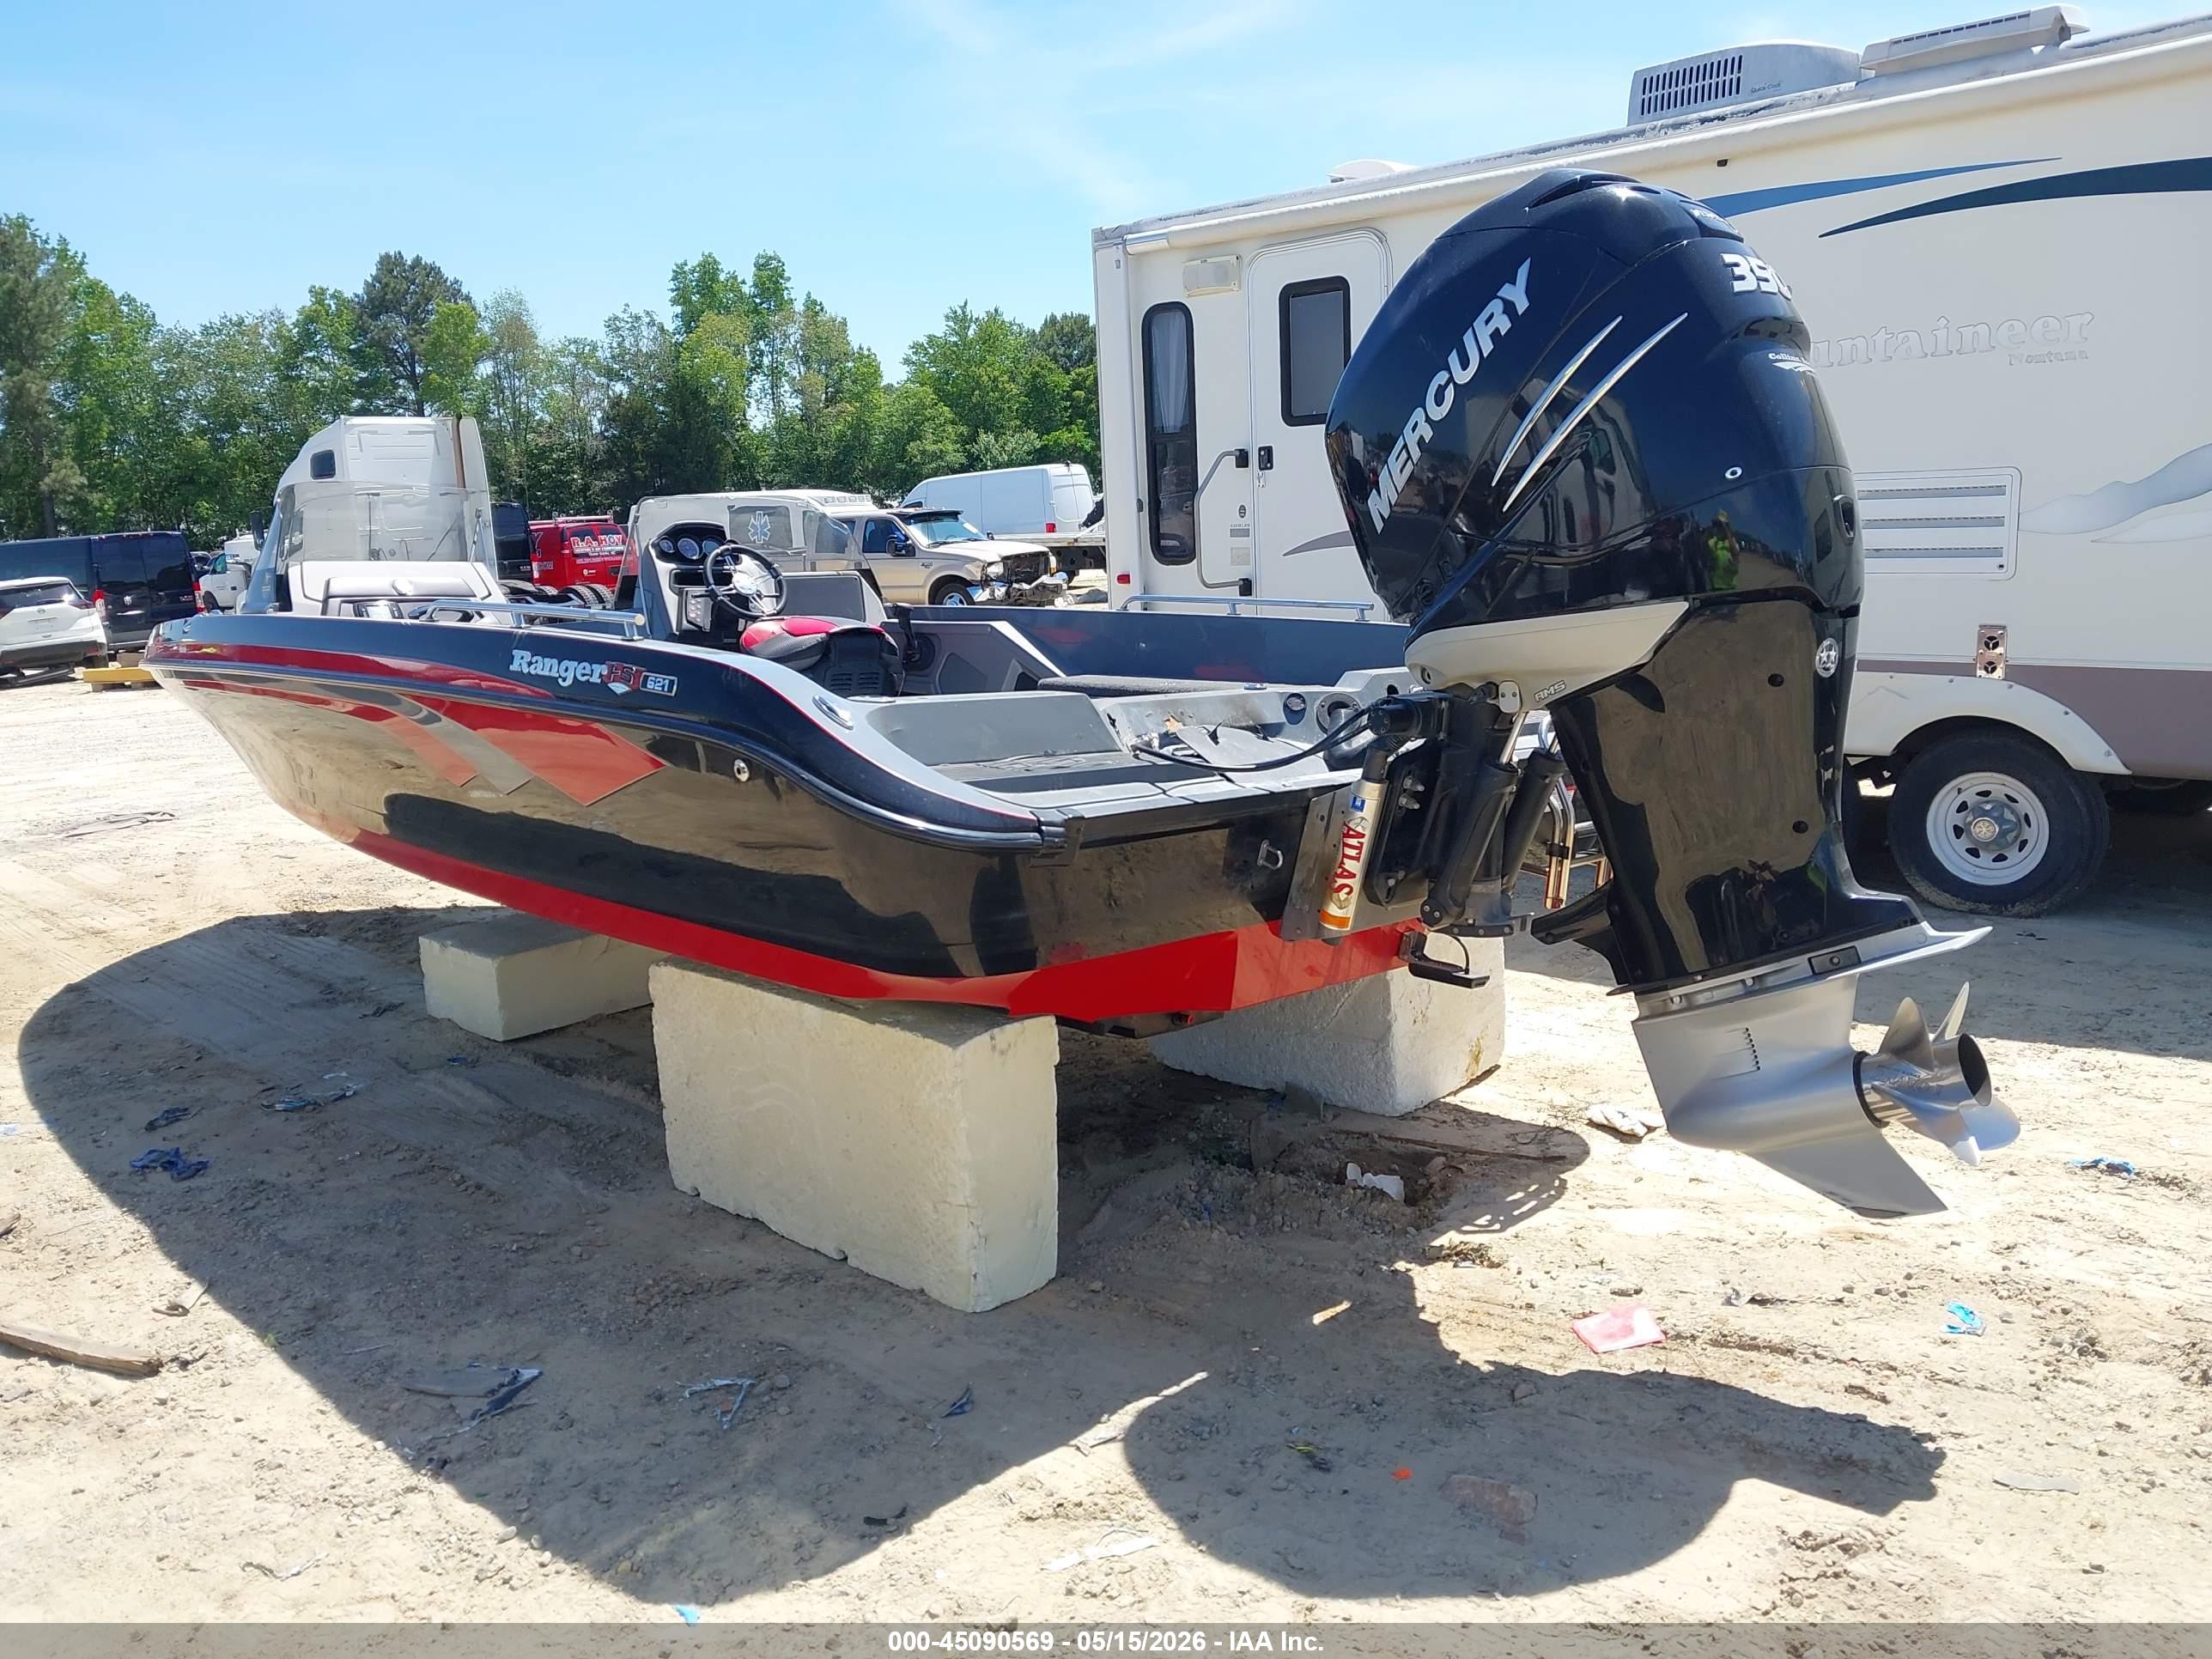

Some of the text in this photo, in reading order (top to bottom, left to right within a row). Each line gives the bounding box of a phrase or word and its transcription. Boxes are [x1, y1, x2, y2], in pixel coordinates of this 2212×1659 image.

[1808, 312, 2095, 368] untaineer
[1367, 256, 1532, 535] MERCURY
[598, 534, 623, 546] HOY
[508, 648, 608, 687] Ranger
[646, 676, 671, 692] 621
[1332, 820, 1366, 897] ATLAS
